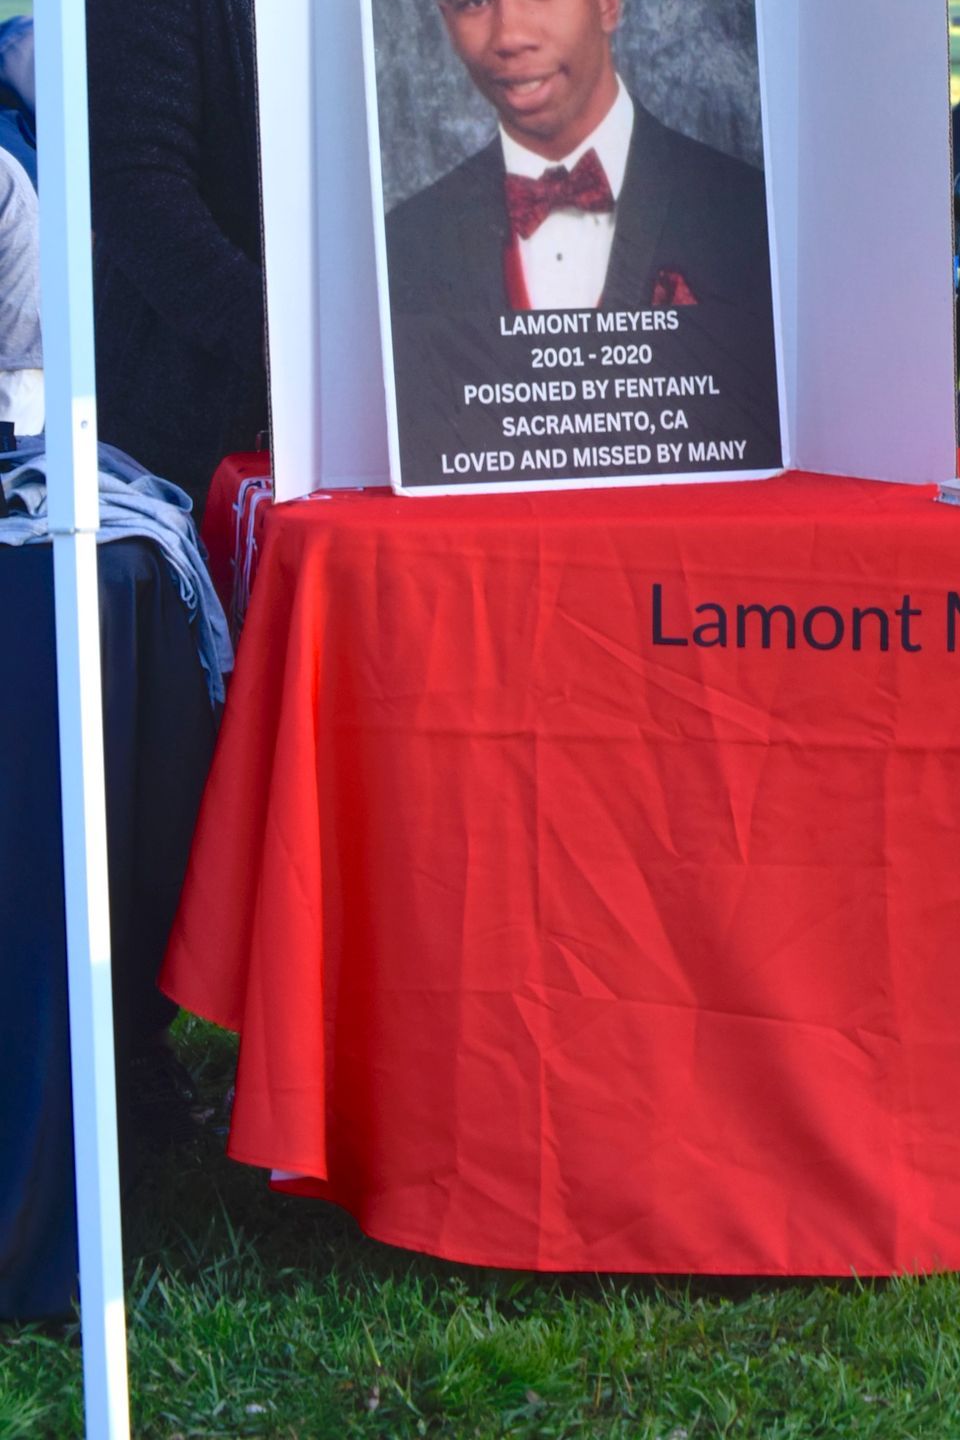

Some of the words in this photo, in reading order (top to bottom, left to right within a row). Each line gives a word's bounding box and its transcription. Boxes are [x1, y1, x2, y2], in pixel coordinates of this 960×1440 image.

[500, 312, 591, 336] LAMONT
[597, 310, 679, 333] MEYERS
[531, 347, 584, 368] 2001
[600, 344, 653, 365] 2020
[464, 380, 577, 405] POISONED
[582, 378, 609, 400] BY
[614, 375, 720, 398] FENTANYL
[502, 411, 656, 437] SACRAMENTO,
[660, 409, 689, 430] CA
[441, 450, 516, 474] LOVED
[520, 447, 568, 470] AND
[573, 444, 652, 467] MISSED
[657, 442, 684, 463] BY
[688, 439, 747, 461] MANY
[650, 582, 923, 654] Lamont
